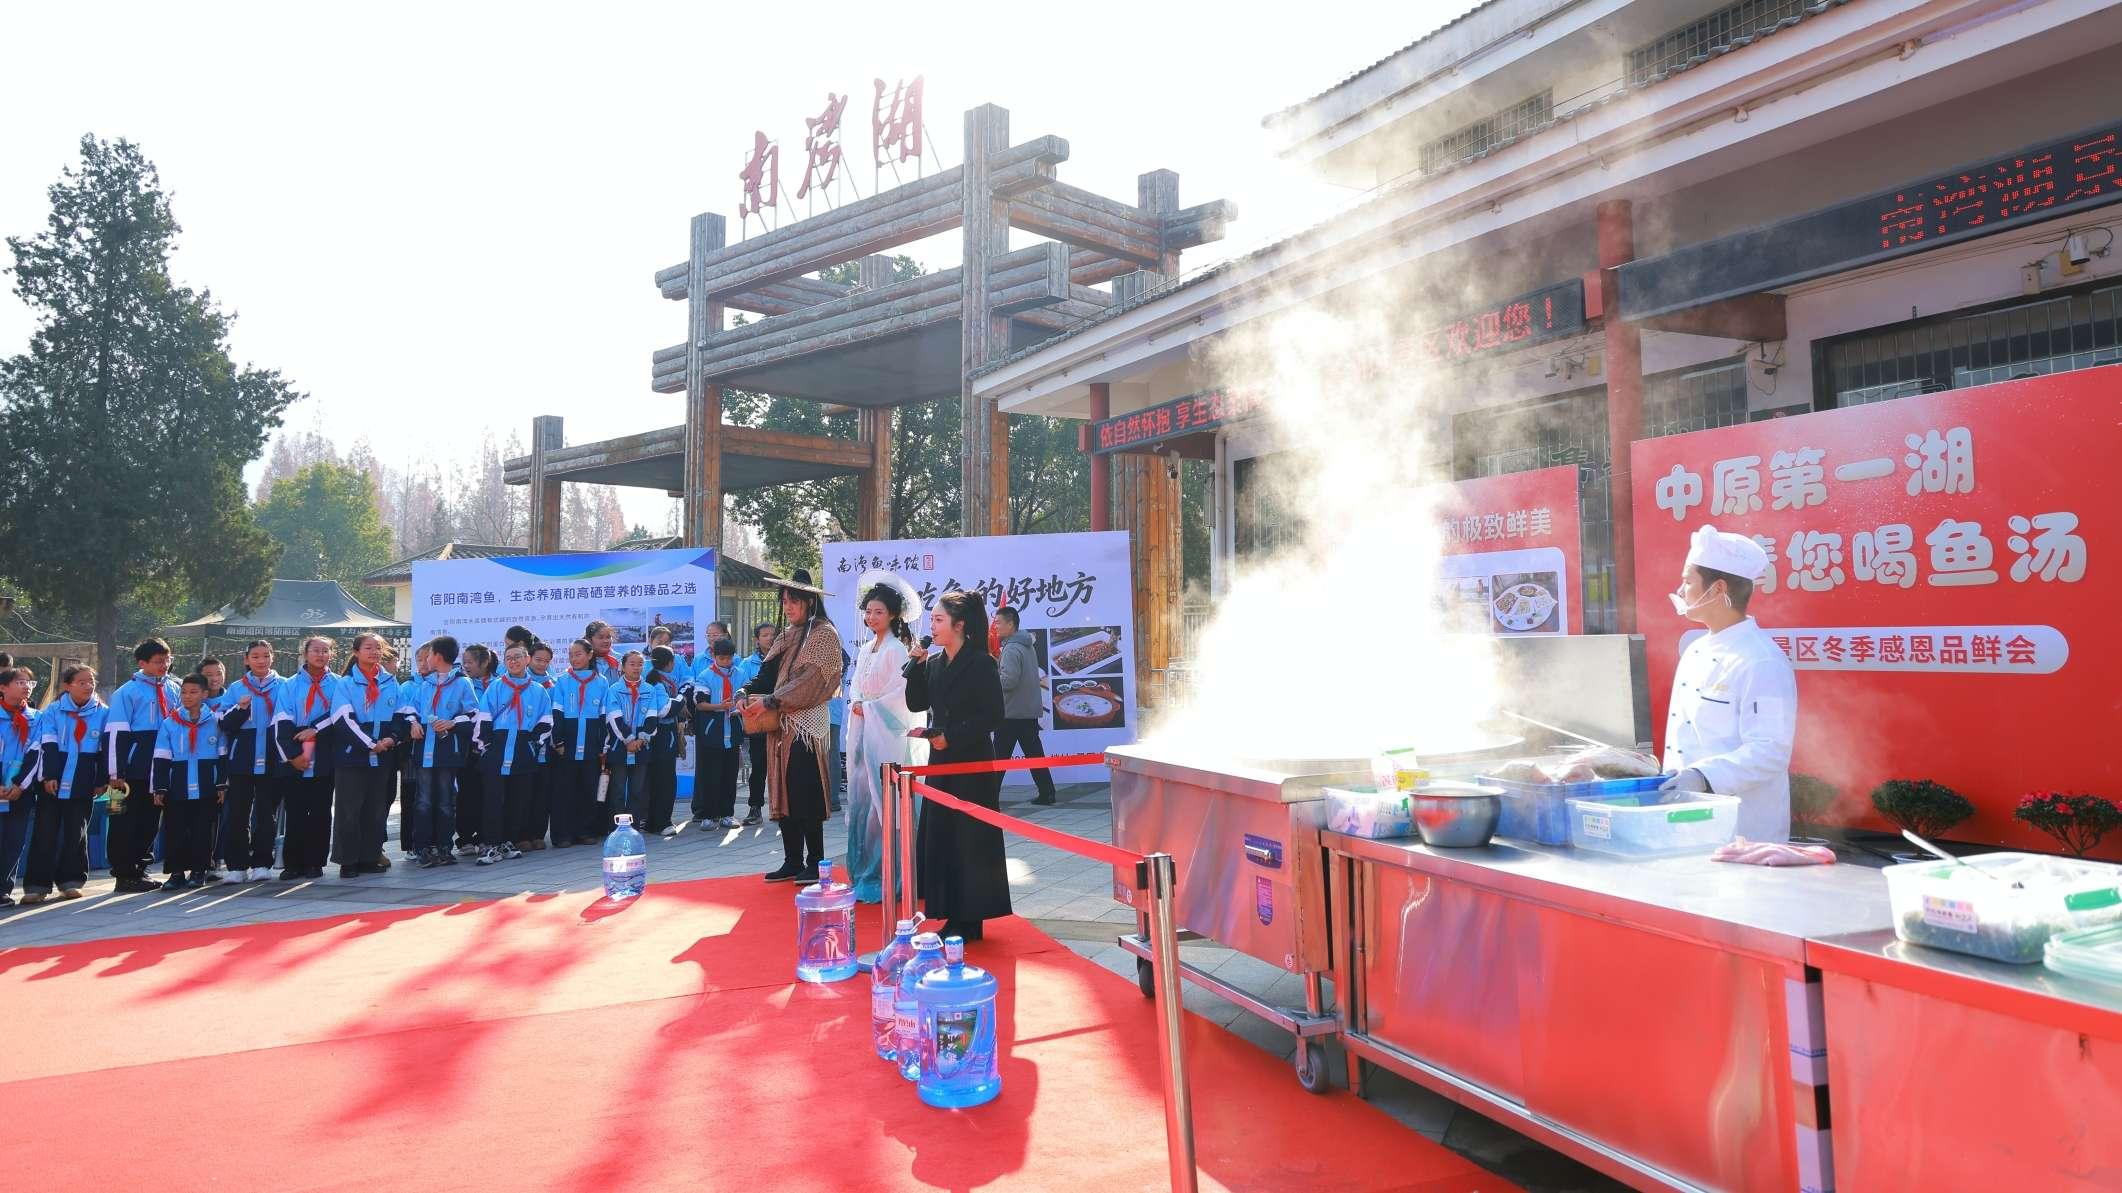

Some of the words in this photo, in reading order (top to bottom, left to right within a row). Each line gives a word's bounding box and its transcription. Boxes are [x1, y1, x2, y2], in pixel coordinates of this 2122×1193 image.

[1101, 407, 1172, 449] 依自然怀抱
[1655, 426, 1976, 521] 中原第一湖
